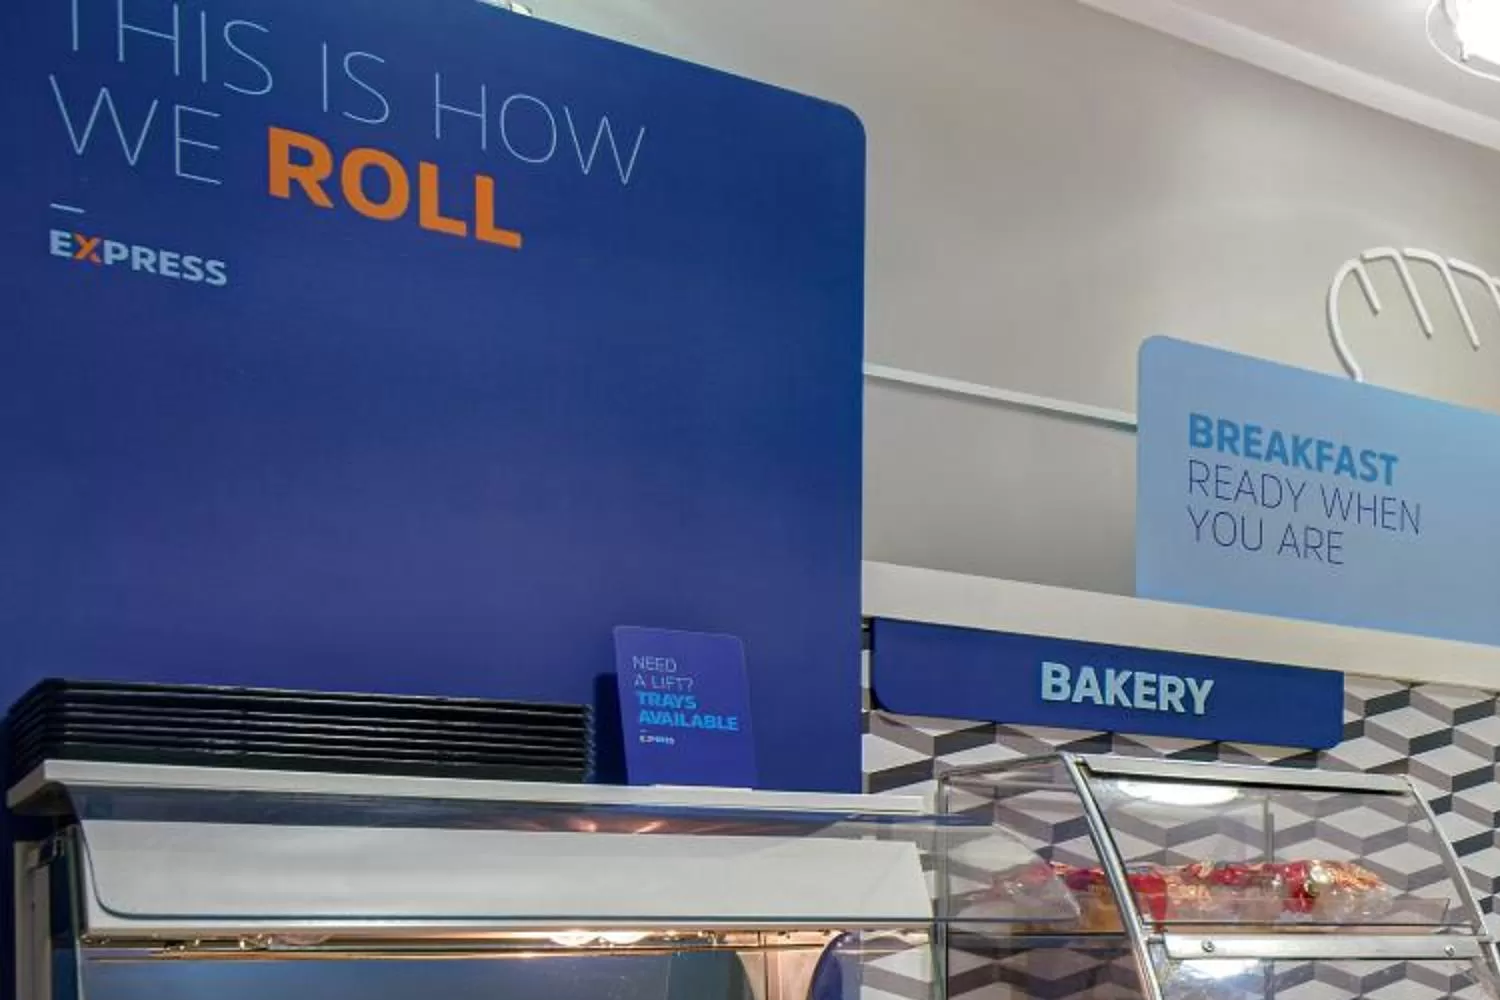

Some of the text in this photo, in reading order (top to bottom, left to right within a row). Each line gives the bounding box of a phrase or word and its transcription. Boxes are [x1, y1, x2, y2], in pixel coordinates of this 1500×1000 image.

[321, 43, 390, 125] IS
[434, 72, 645, 184] HOW
[49, 73, 523, 249] WE ROLL
[50, 229, 228, 286] EXPRESS
[1189, 412, 1399, 486] BREAKFAST
[1188, 459, 1422, 536] READY WHEN
[1186, 504, 1345, 565] YOU ARE
[632, 655, 677, 673] NEED
[634, 674, 694, 692] A LIFT?
[1041, 661, 1216, 716] BAKERY
[638, 691, 697, 709] TRAYS
[639, 710, 740, 731] AVAILABLE
